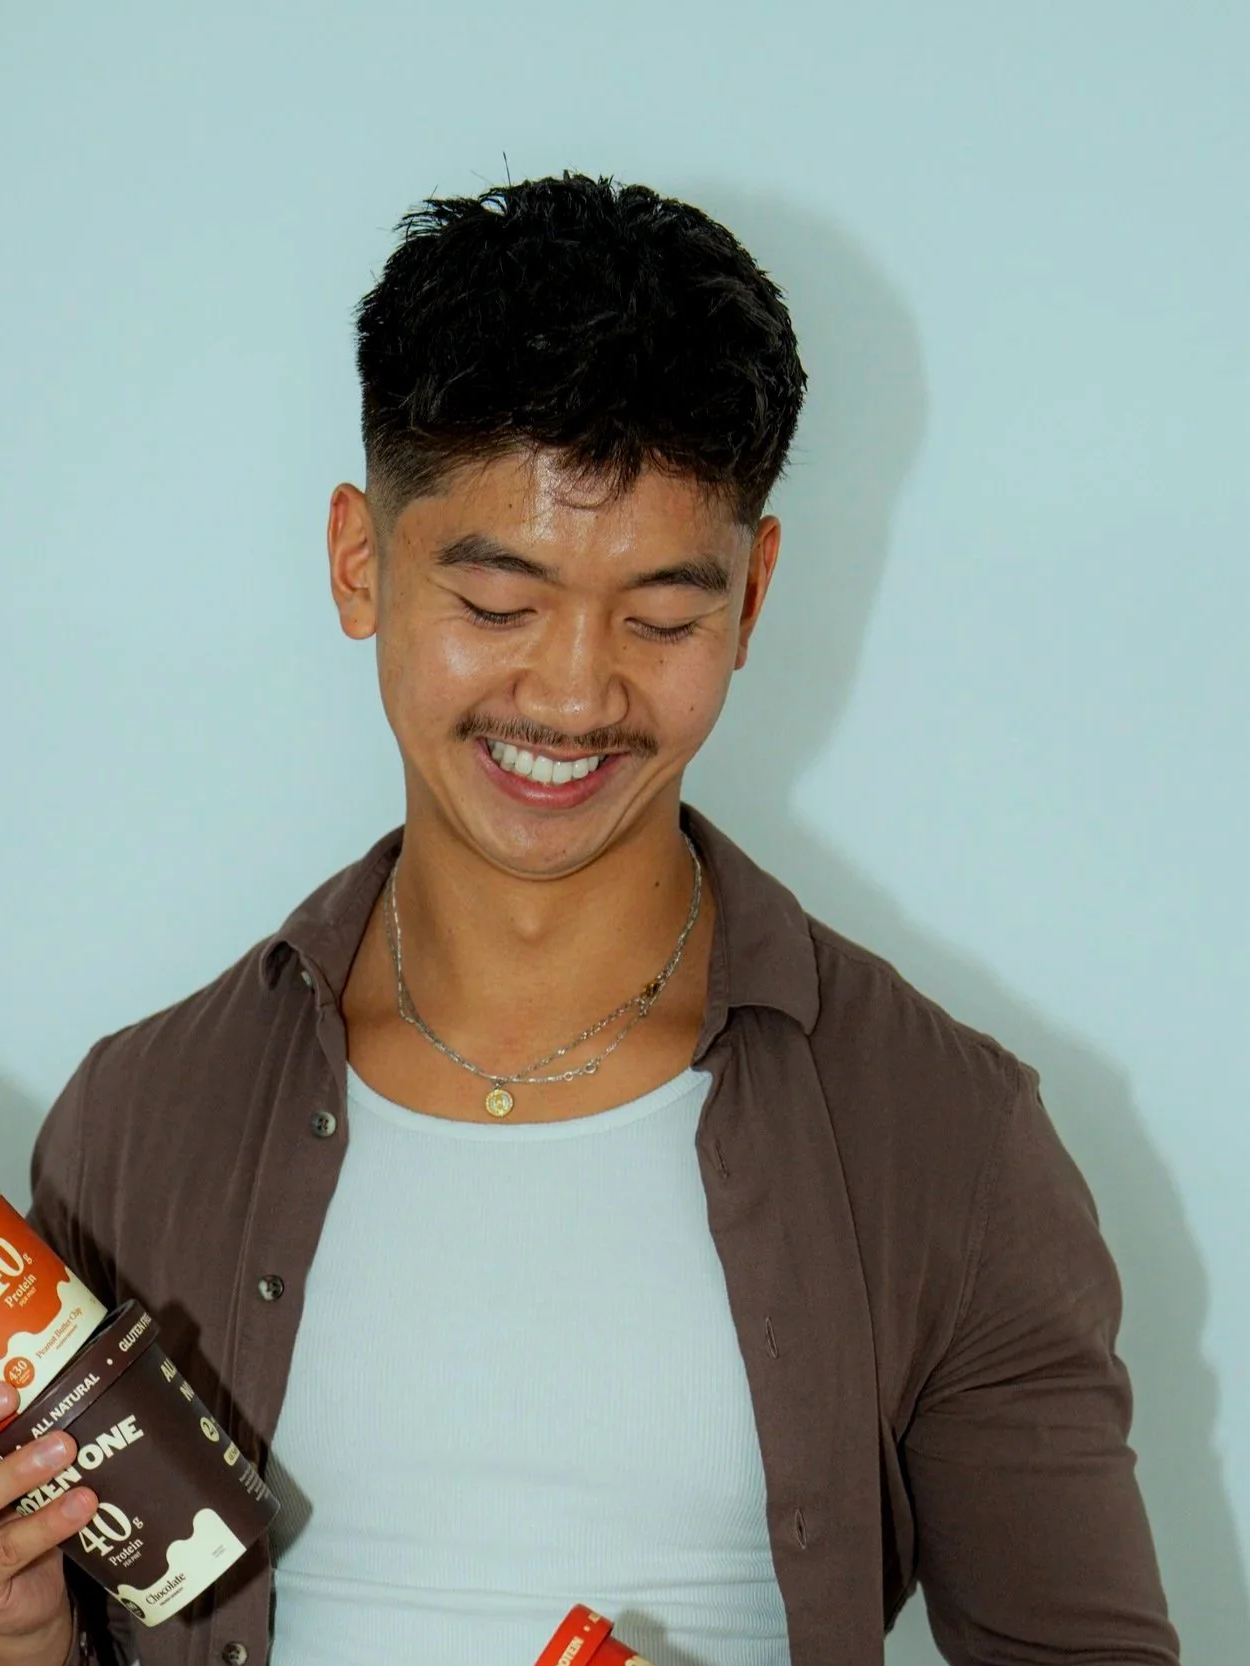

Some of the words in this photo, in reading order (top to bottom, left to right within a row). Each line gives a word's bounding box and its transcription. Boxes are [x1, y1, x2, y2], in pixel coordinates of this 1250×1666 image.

[4, 1273, 37, 1308] Protein
[36, 1334, 56, 1359] Peanut
[54, 1320, 71, 1338] Butter
[69, 1306, 83, 1322] Chip
[8, 1360, 28, 1381] 430
[31, 1416, 54, 1439] ALL
[50, 1373, 100, 1421] NATURAL
[119, 1322, 146, 1352] GLUTEN
[77, 1414, 144, 1470] ONE
[109, 1538, 144, 1566] Protein
[145, 1573, 186, 1605] Chocolate
